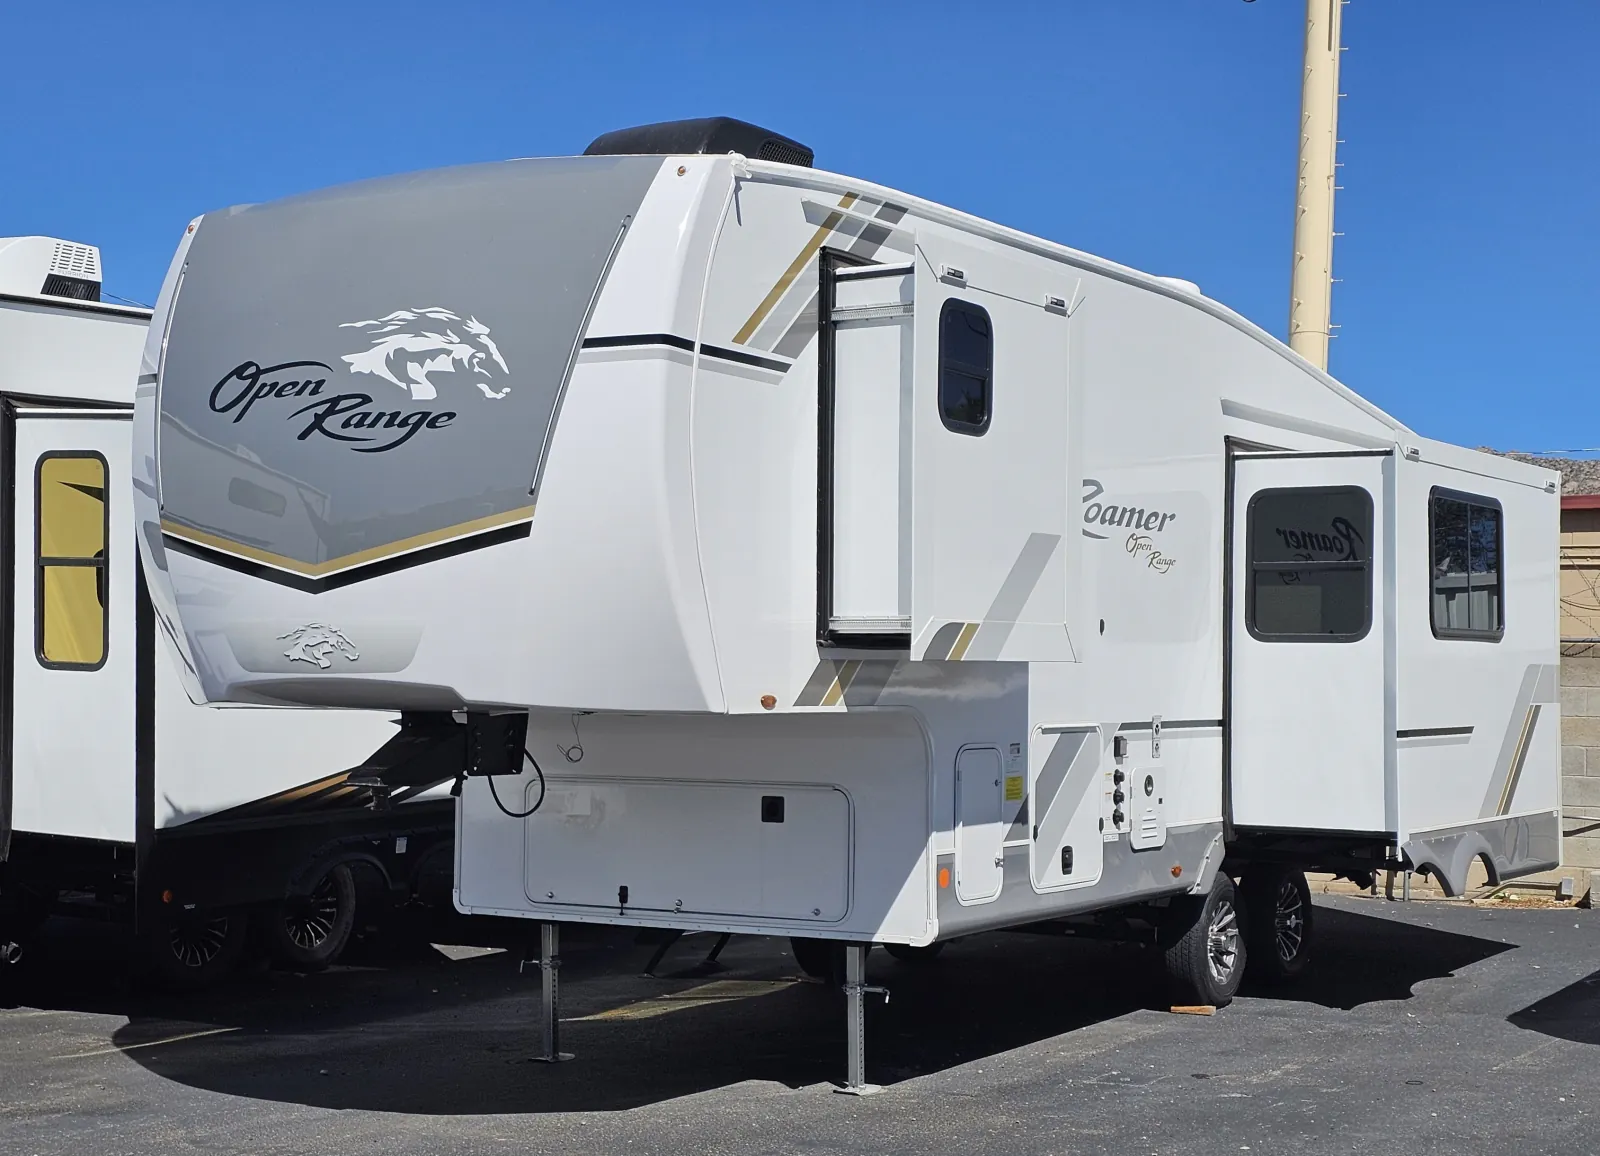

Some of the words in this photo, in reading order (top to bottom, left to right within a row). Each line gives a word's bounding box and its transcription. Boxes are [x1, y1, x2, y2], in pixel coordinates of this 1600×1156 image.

[209, 360, 334, 423] Open
[287, 393, 457, 453] Range
[1125, 532, 1153, 558] Open
[1145, 551, 1176, 574] Range
